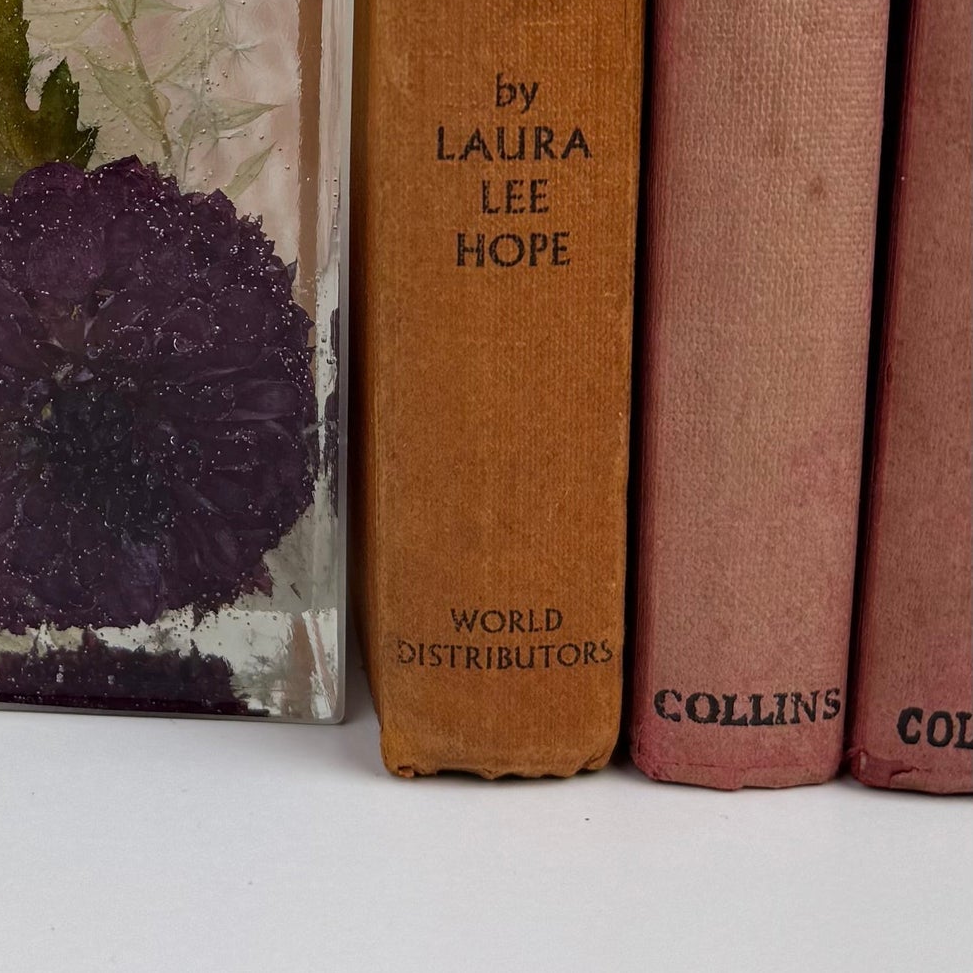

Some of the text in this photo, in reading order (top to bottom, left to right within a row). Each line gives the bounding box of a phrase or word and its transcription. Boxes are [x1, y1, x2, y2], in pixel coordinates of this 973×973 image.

[495, 73, 539, 114] by
[436, 126, 593, 162] LAURA
[482, 179, 550, 214] LEE
[456, 230, 571, 267] HOPE
[450, 608, 564, 633] WORLD
[397, 638, 613, 670] DISTRIBUTORS
[653, 687, 842, 727] COLLINS
